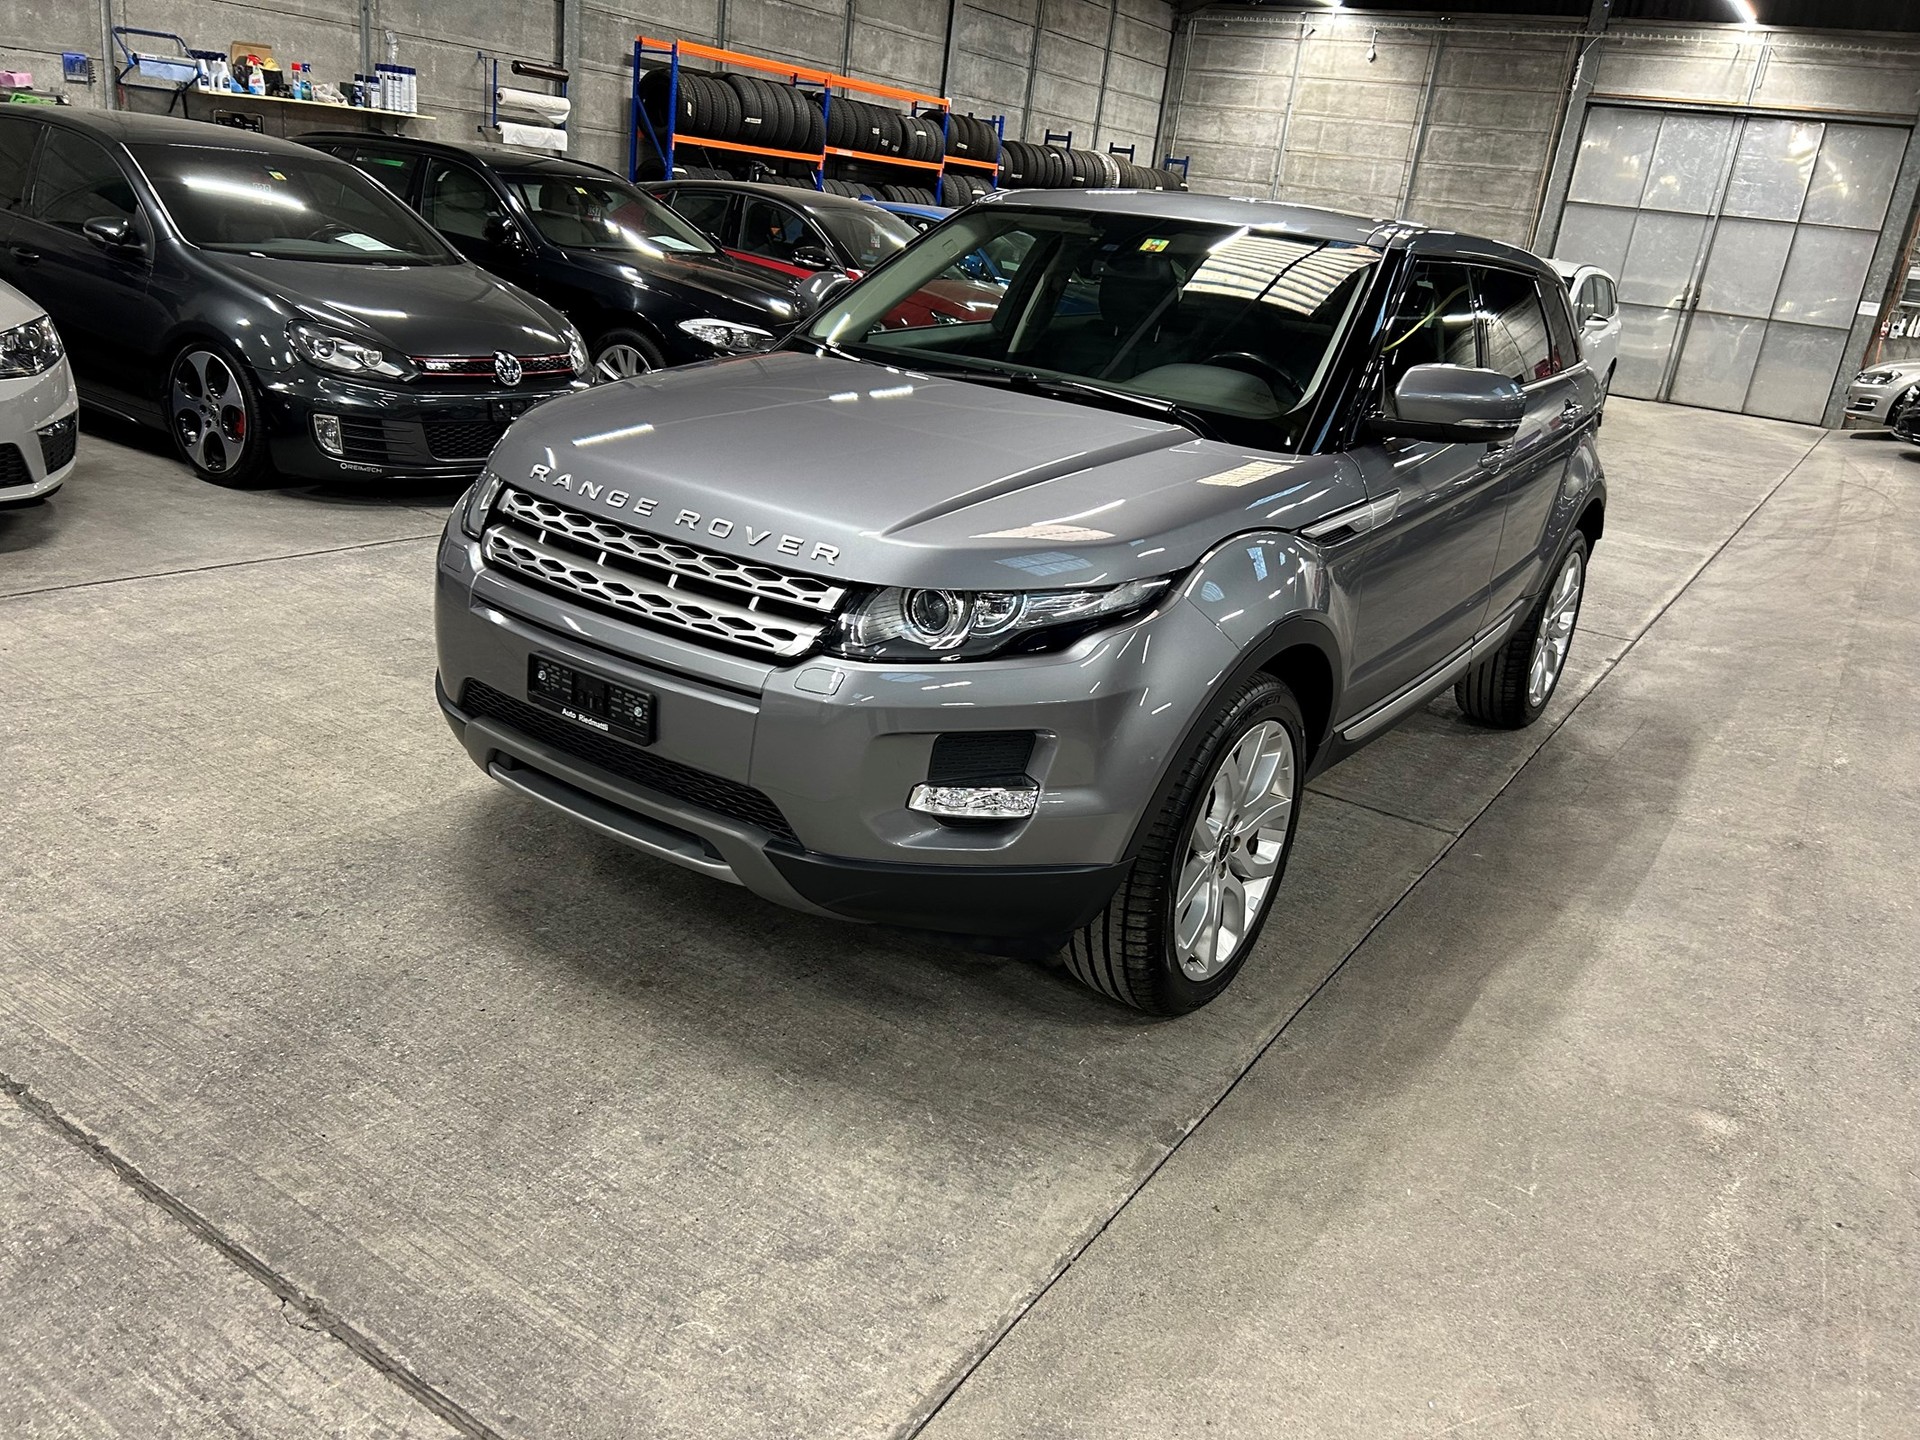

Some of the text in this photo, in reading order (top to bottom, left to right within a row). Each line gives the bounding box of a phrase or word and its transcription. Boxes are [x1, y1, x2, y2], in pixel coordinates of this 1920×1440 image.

[529, 463, 841, 566] RANGE ROVER
[561, 707, 577, 719] Auto
